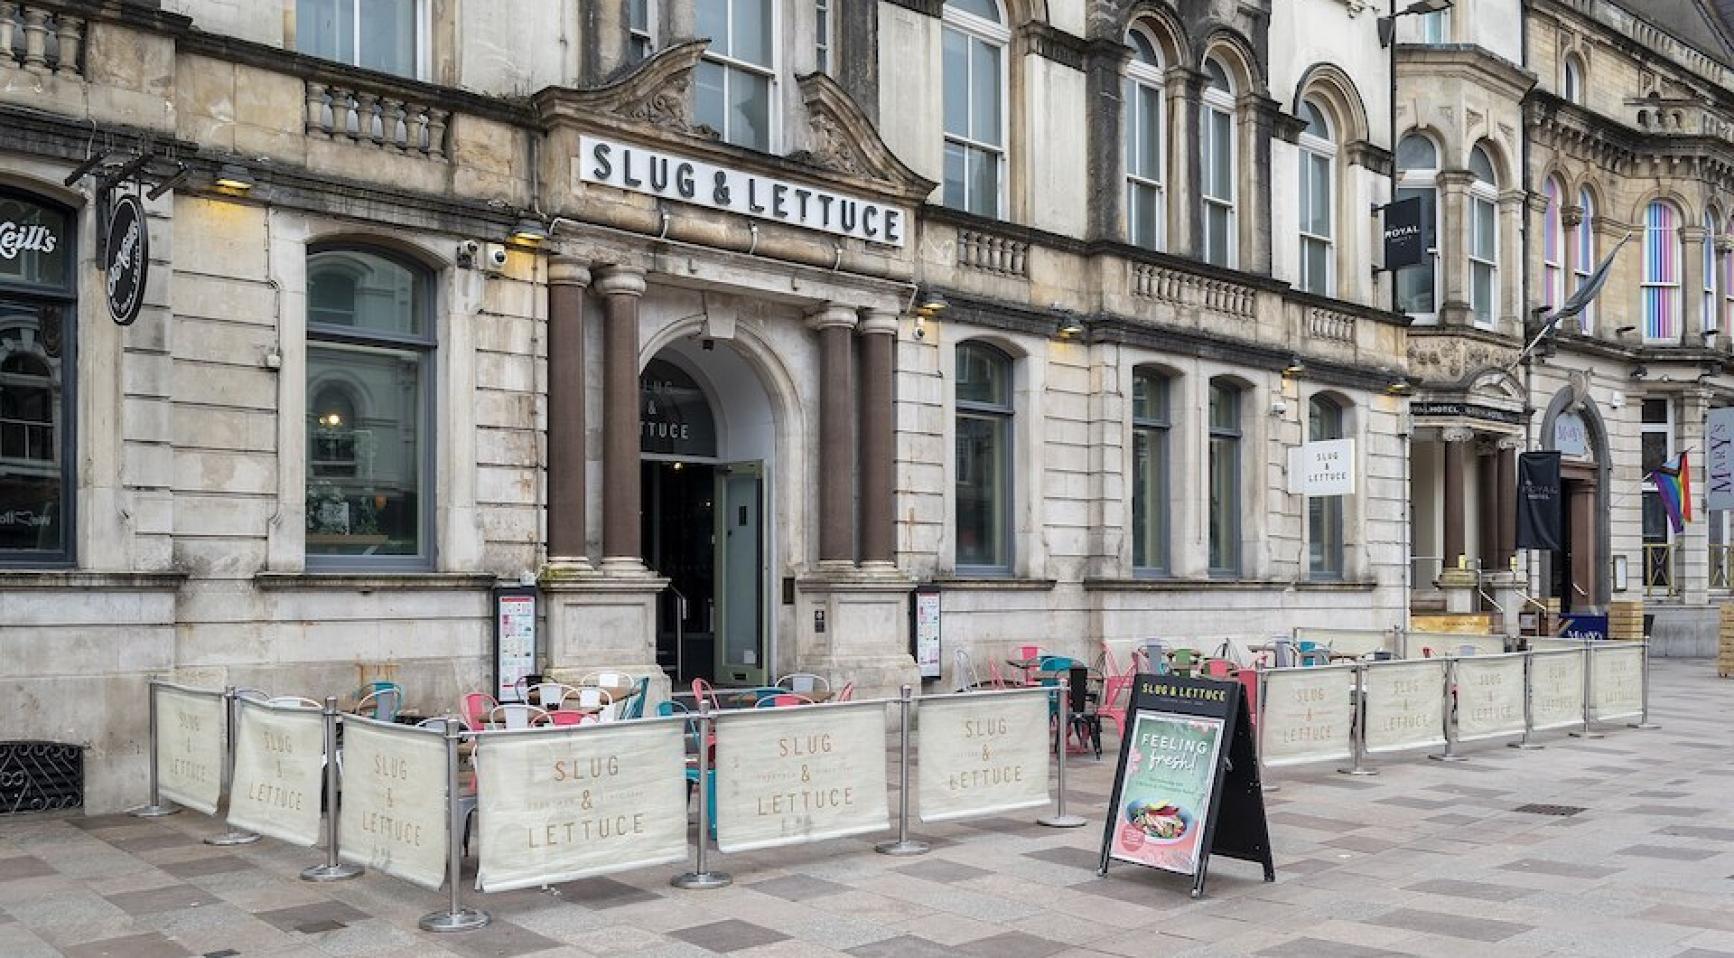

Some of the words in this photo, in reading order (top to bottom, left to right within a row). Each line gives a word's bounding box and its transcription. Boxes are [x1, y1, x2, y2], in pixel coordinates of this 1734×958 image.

[592, 142, 696, 200] SLUG
[712, 169, 732, 206] &
[748, 178, 900, 241] LETTUCE
[641, 380, 674, 394] LUG
[647, 400, 657, 415] &
[639, 422, 689, 440] TTUCE
[1316, 452, 1339, 461] SLUG
[1309, 472, 1347, 482] LETTUCE
[1142, 683, 1169, 696] SLUG
[1179, 687, 1226, 701] LETTUCE
[966, 718, 1008, 738] SLUG
[1283, 726, 1332, 743] LETTUCE
[263, 731, 293, 753] SLUG
[779, 733, 832, 757] SLUG
[982, 744, 991, 761] &
[1141, 733, 1208, 755] FEELING
[375, 753, 408, 780] SLUG
[554, 755, 619, 781] SLUG
[801, 764, 811, 782] &
[950, 766, 1023, 790] LETTUCE
[249, 783, 303, 811] LETTUCE
[581, 789, 593, 810] &
[758, 787, 854, 816] LETTUCE
[362, 810, 422, 847] LETTUCE
[528, 812, 646, 849] LETTUCE
